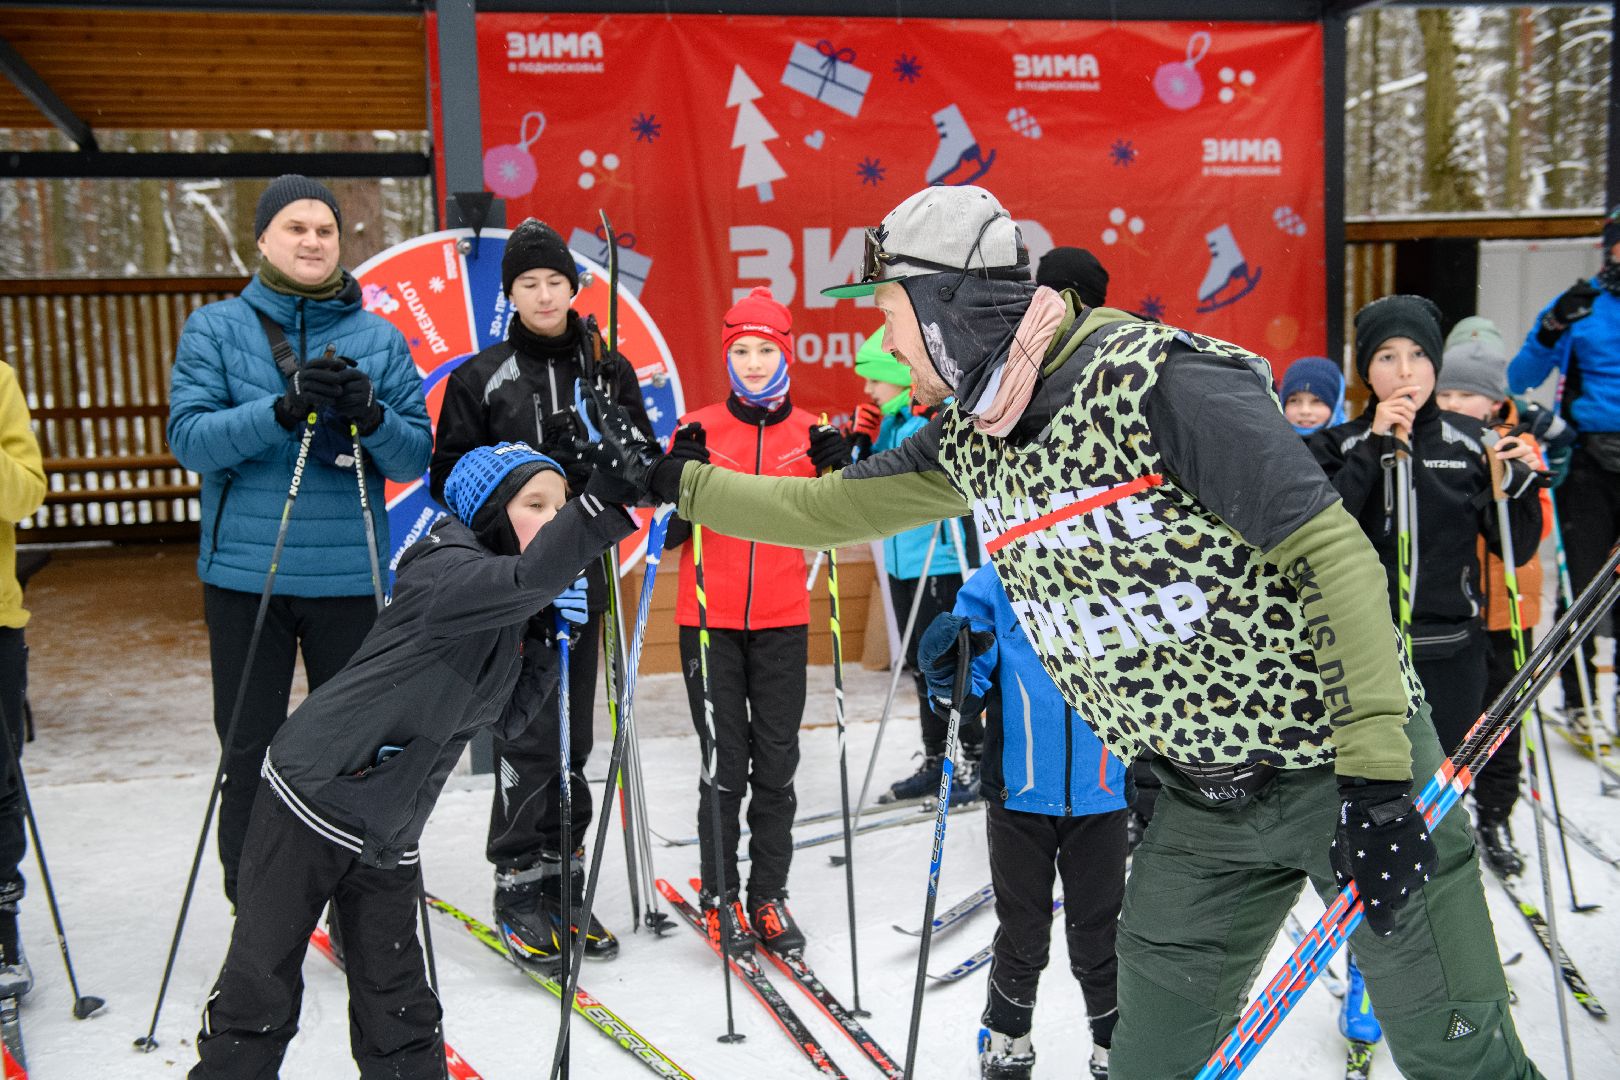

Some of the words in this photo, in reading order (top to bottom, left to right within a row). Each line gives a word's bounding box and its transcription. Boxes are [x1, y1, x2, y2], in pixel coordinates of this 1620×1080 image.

[506, 32, 603, 58] ЗИМА
[1013, 53, 1099, 78] ЗИМА
[1202, 137, 1282, 162] ЗИМА
[397, 280, 449, 356] ДЖЕКПОТ
[1307, 615, 1336, 651] IS
[931, 771, 952, 864] SPORTER
